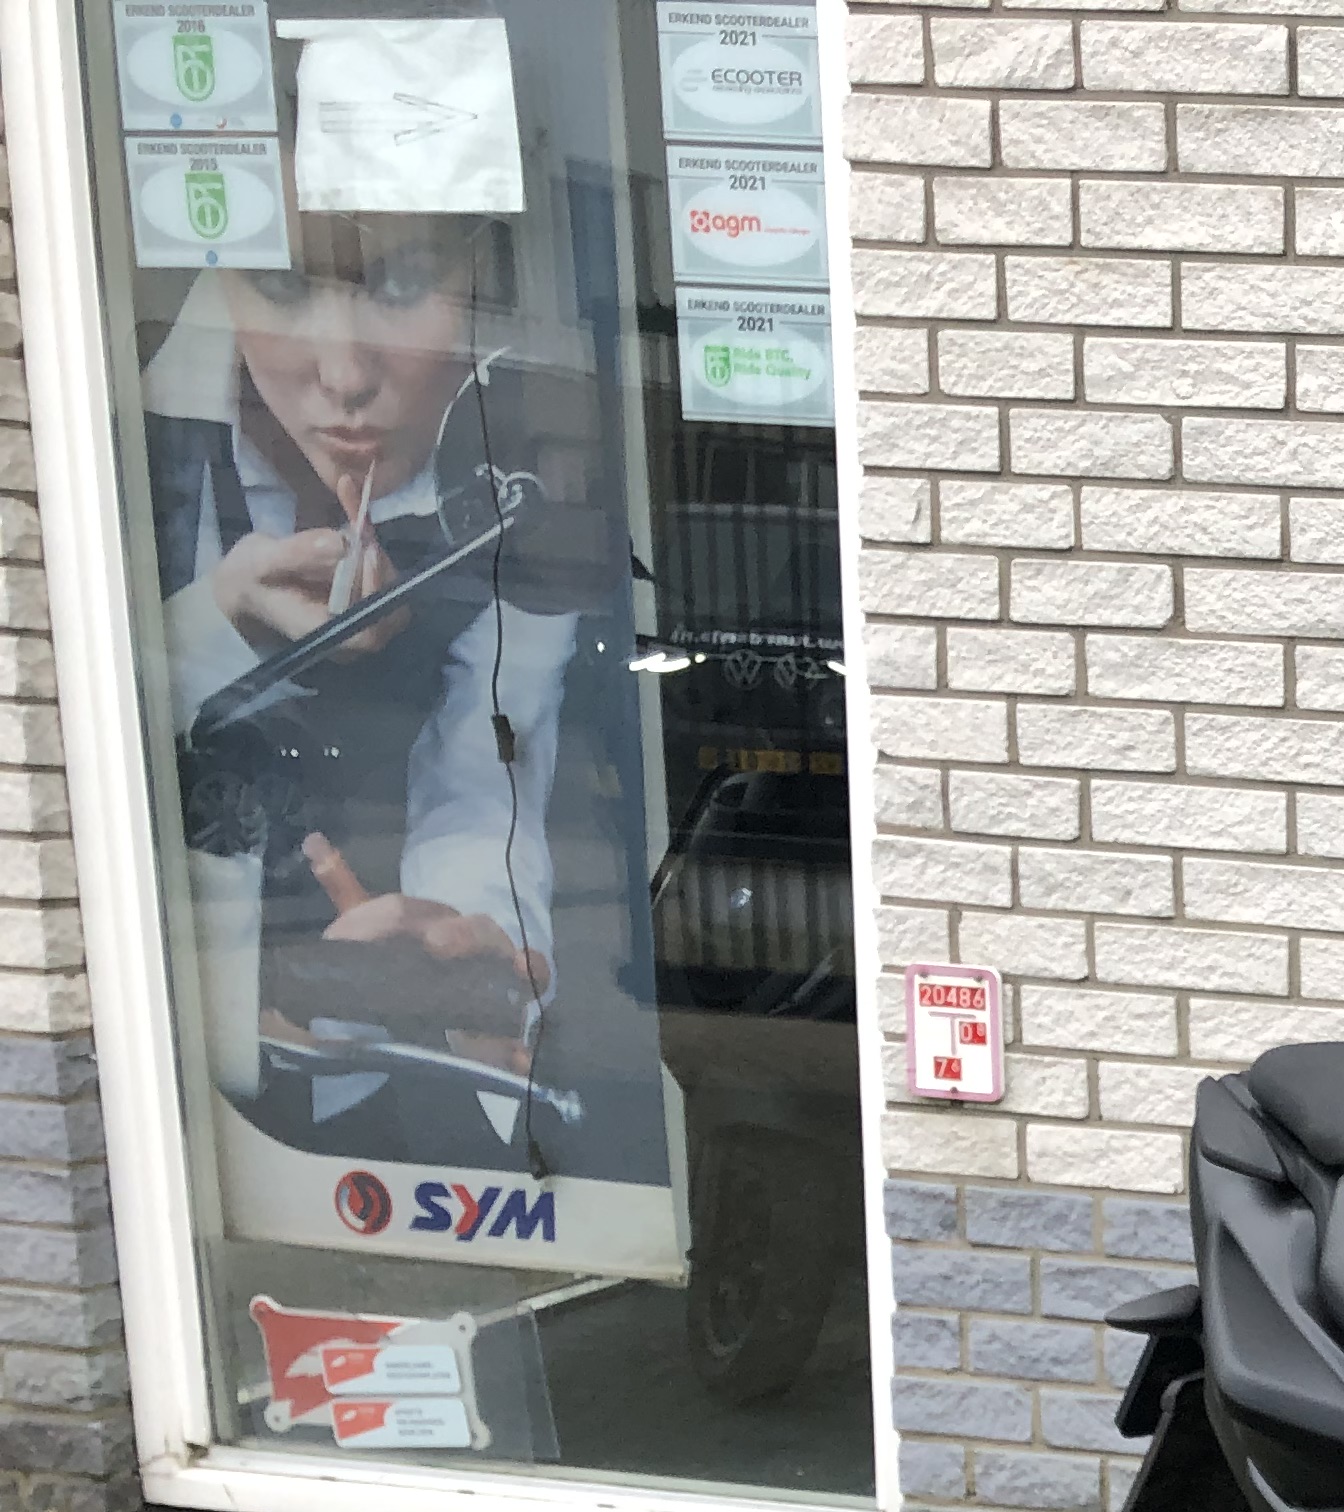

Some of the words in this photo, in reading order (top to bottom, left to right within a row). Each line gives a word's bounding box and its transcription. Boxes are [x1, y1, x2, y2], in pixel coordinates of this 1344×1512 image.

[668, 12, 711, 25] ERKEND
[714, 13, 809, 28] SCOOTERDEALER
[718, 30, 757, 46] 2021
[711, 68, 803, 87] ECOOTER
[679, 157, 721, 170] ERKEND
[724, 159, 817, 174] SCOOTERDEALER
[728, 174, 766, 191] 2021
[712, 215, 762, 238] agm
[736, 316, 774, 332] 2021
[919, 983, 986, 1009] 20486
[409, 1180, 556, 1243] SYM
